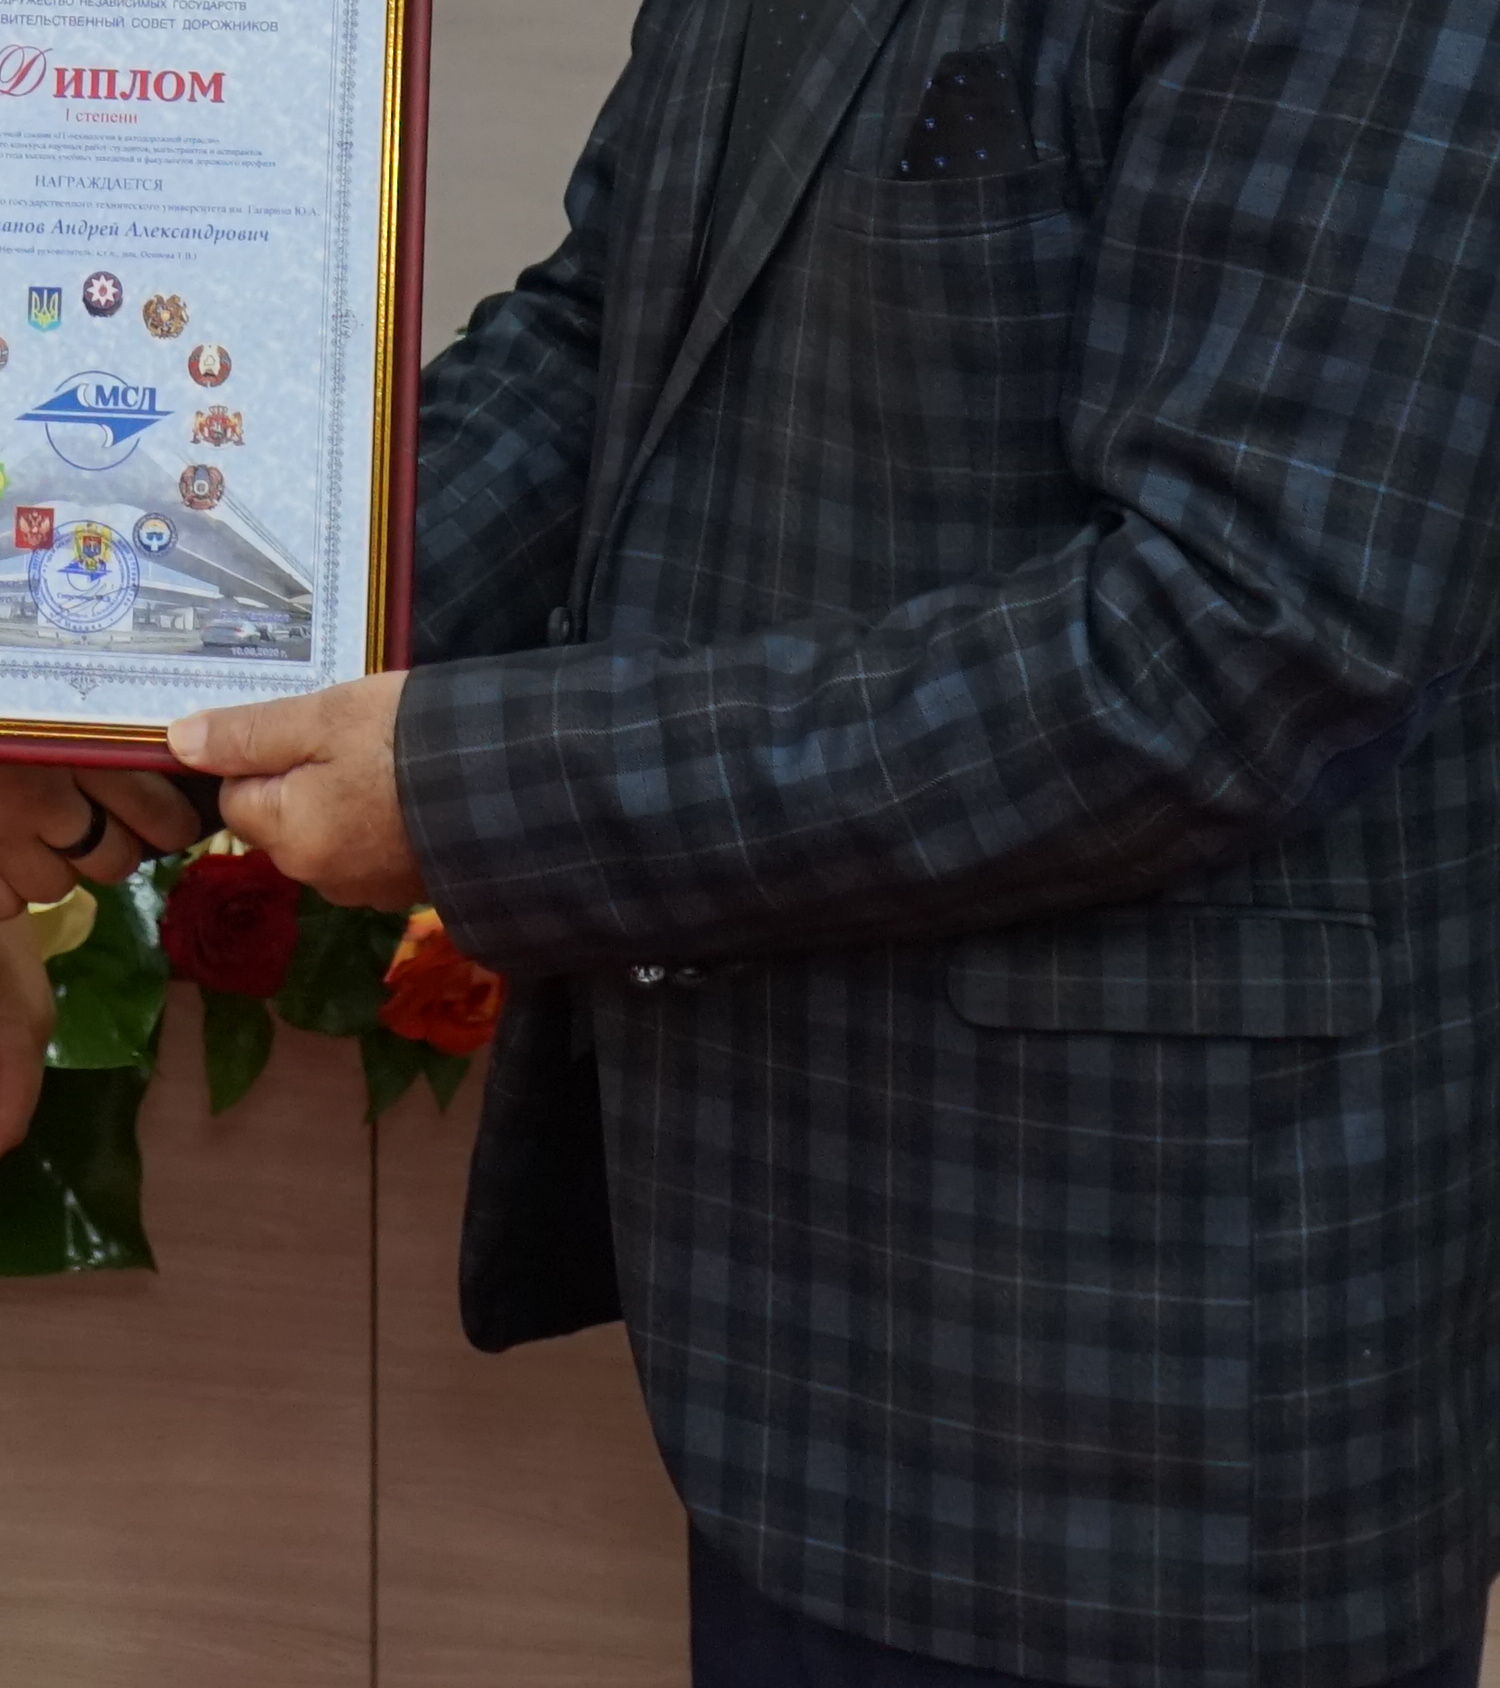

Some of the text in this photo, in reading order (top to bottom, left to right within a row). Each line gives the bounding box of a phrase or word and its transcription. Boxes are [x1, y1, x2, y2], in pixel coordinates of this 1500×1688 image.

[172, 0, 248, 12] ГОСУДАРСТВ
[131, 17, 177, 30] СОВЕТ
[182, 18, 280, 32] ДОРОЖНИКОВ
[75, 111, 139, 124] степени
[35, 174, 163, 192] НАГРАЖДАЕТСЯ
[50, 217, 119, 241] Андрей
[124, 220, 270, 245] Александрович
[95, 384, 157, 411] МСД
